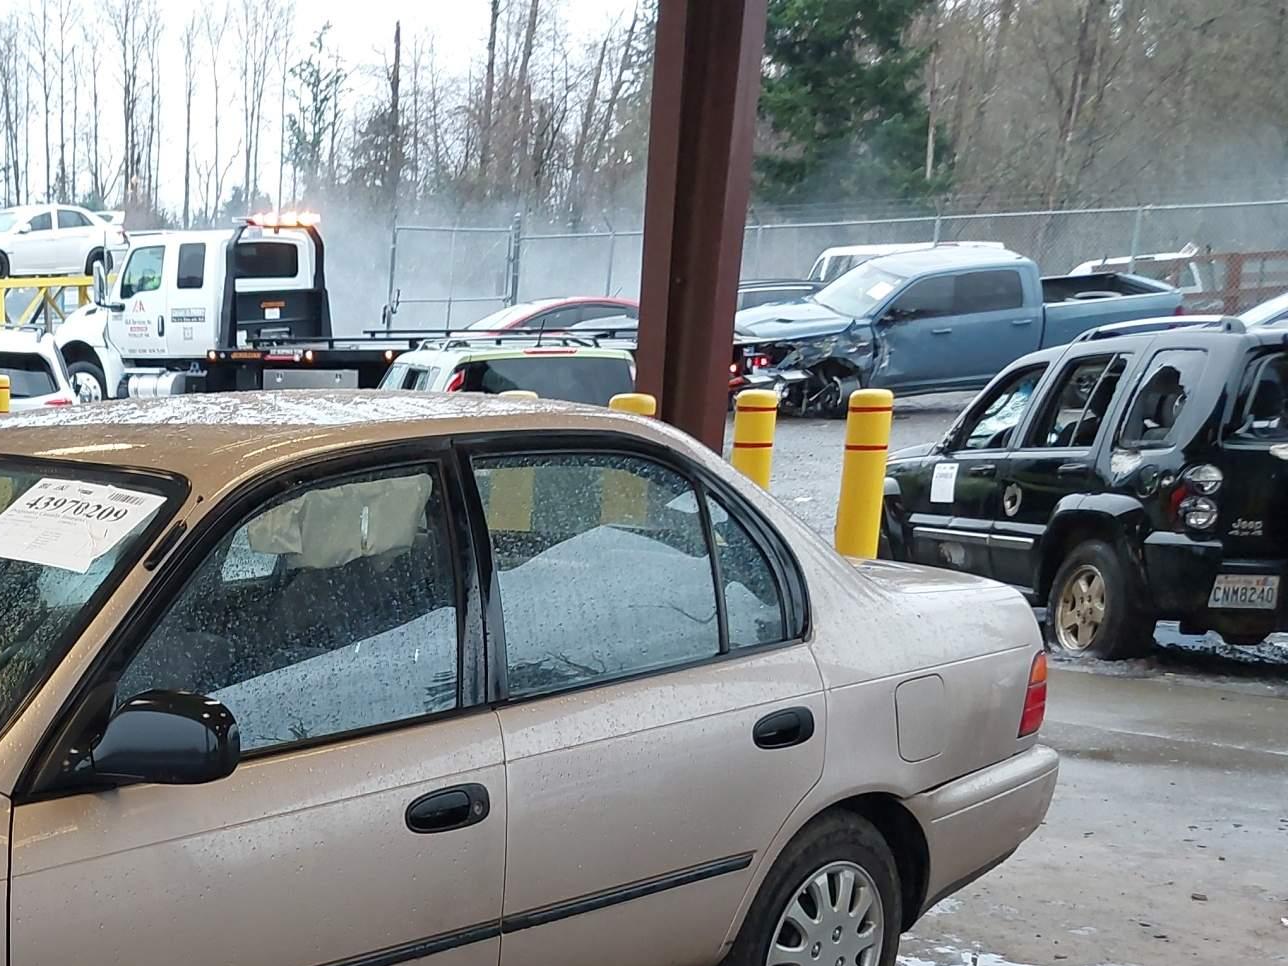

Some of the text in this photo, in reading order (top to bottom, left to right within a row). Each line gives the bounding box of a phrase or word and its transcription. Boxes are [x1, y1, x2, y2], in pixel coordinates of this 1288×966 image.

[25, 495, 128, 522] 43970209
[1232, 518, 1264, 530] Jeep
[1213, 586, 1274, 603] CNM8240
